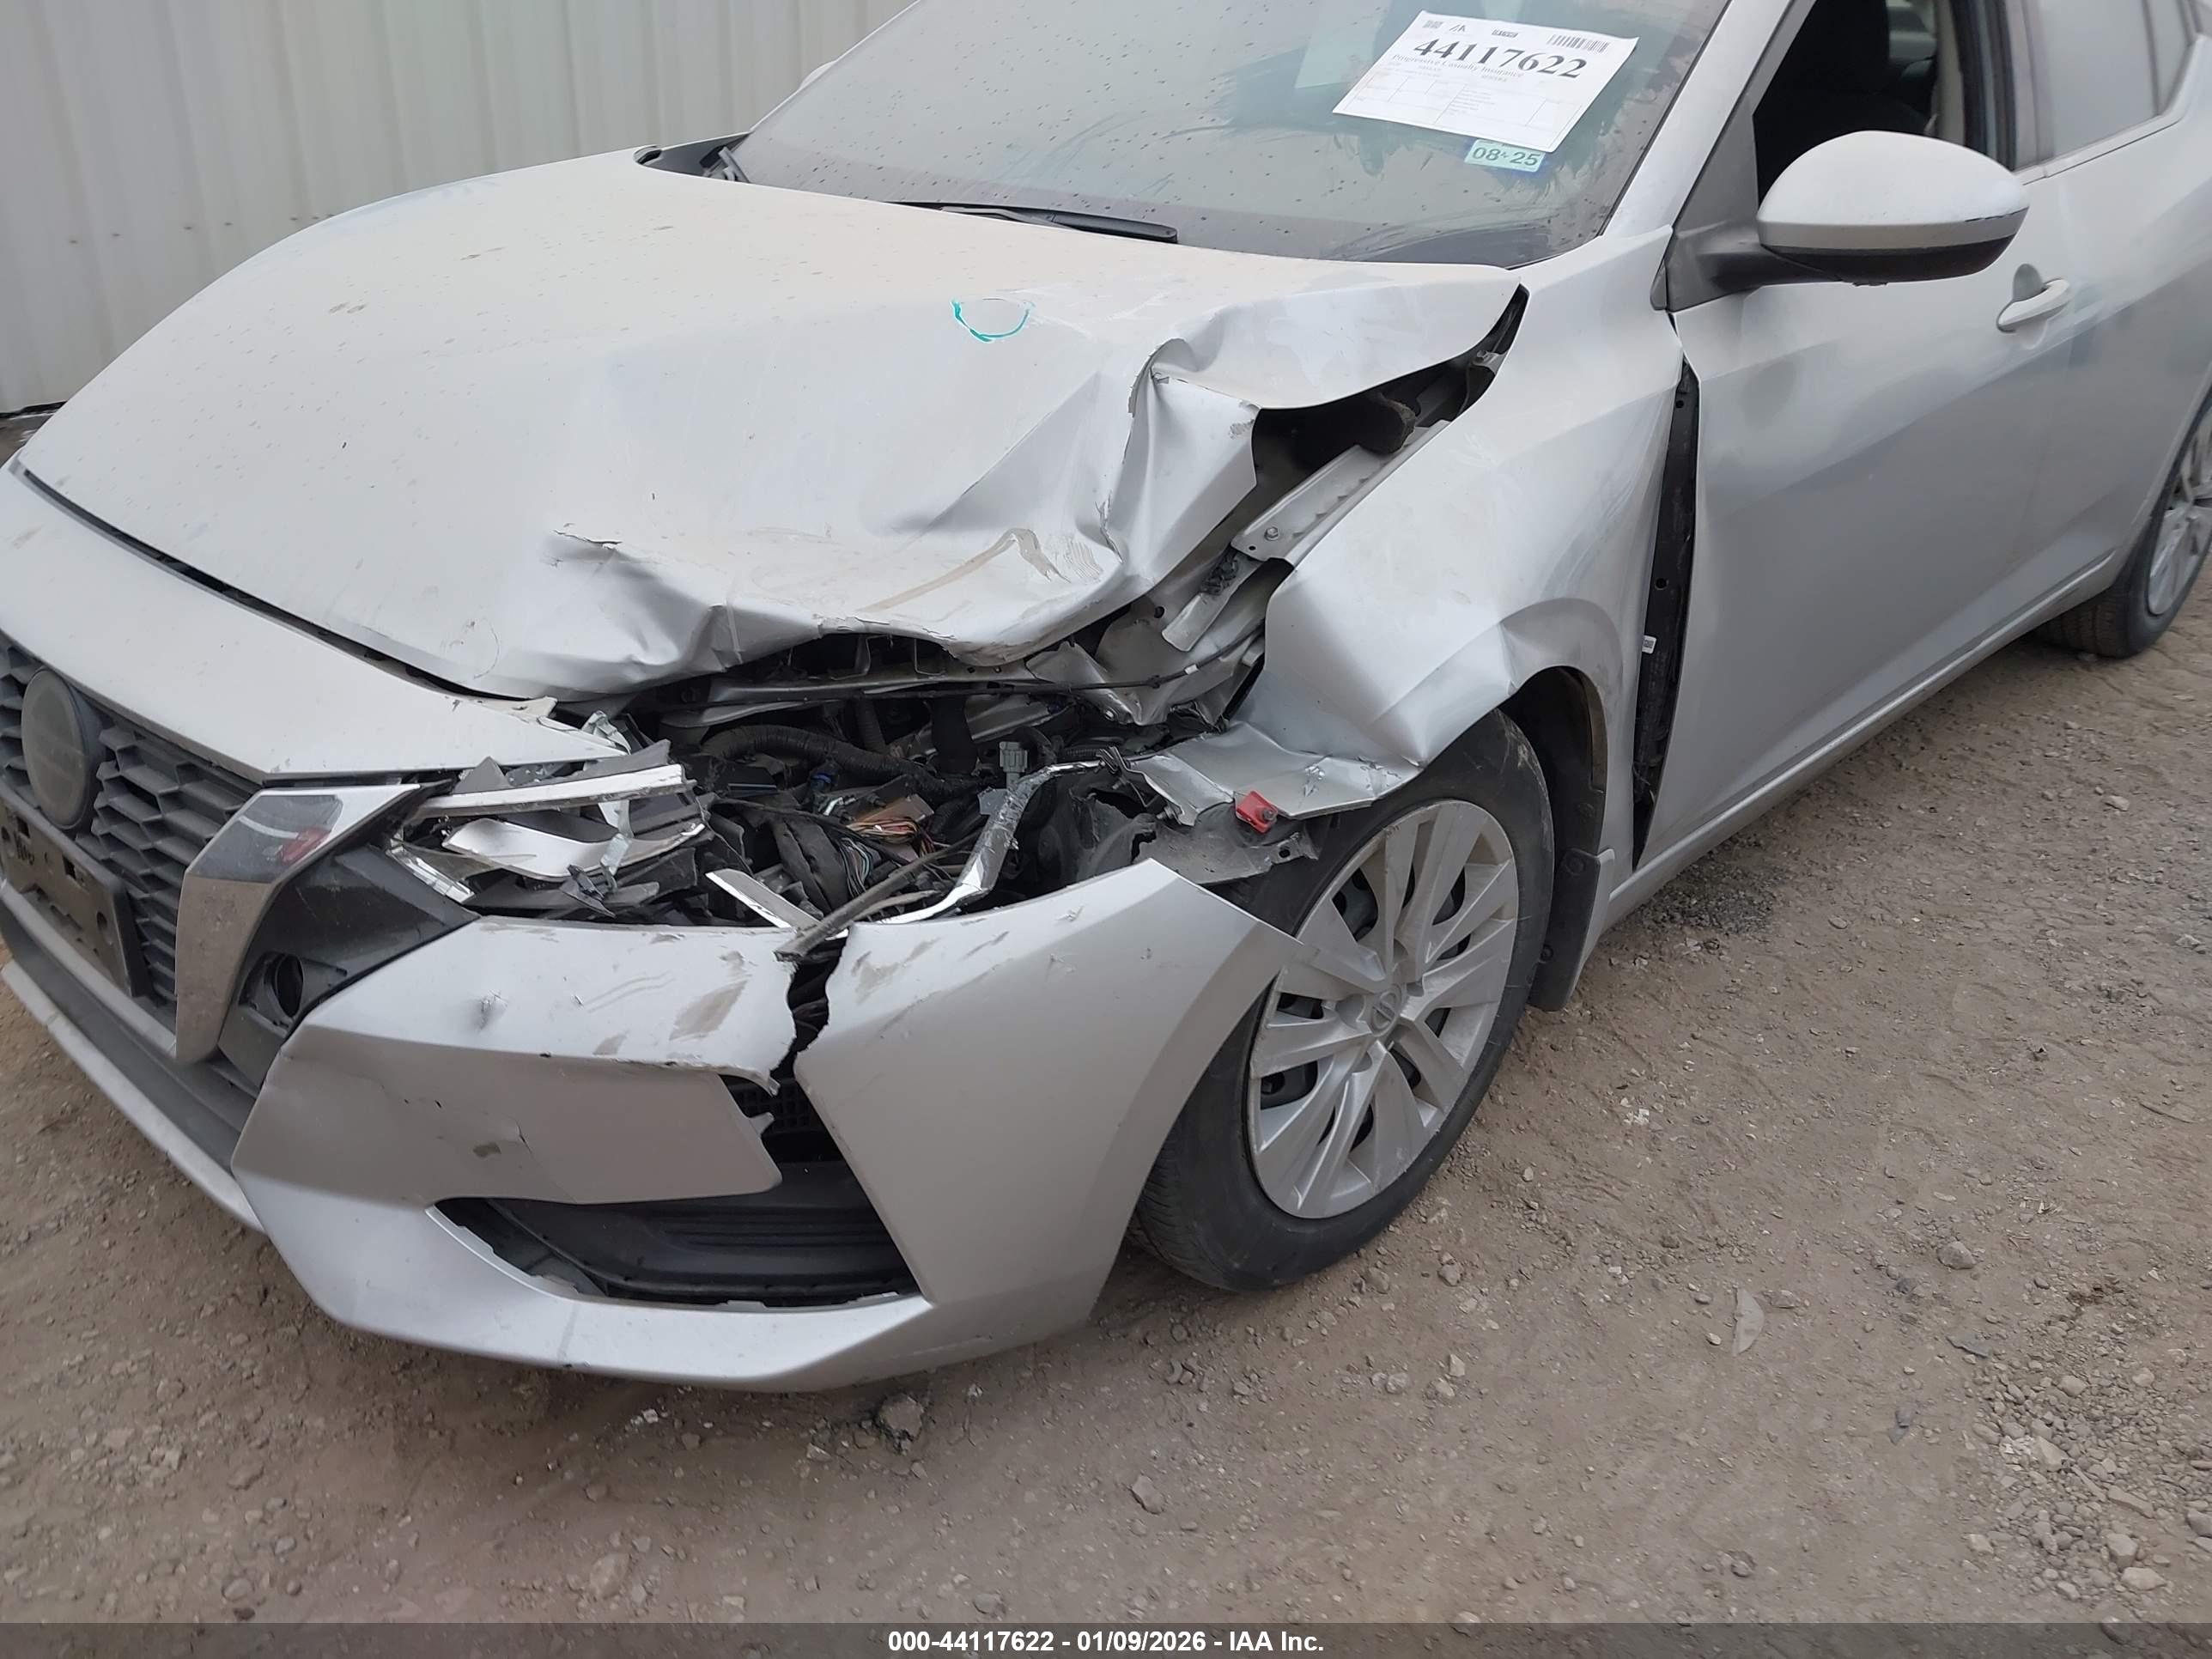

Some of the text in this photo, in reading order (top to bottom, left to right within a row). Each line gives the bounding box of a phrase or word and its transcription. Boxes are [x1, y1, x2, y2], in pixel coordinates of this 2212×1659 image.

[1392, 54, 1441, 67] Progressive
[1443, 60, 1480, 74] Casualty
[1481, 66, 1524, 78] Insurance
[1413, 38, 1588, 79] 44117622
[1472, 147, 1541, 166] 08 25
